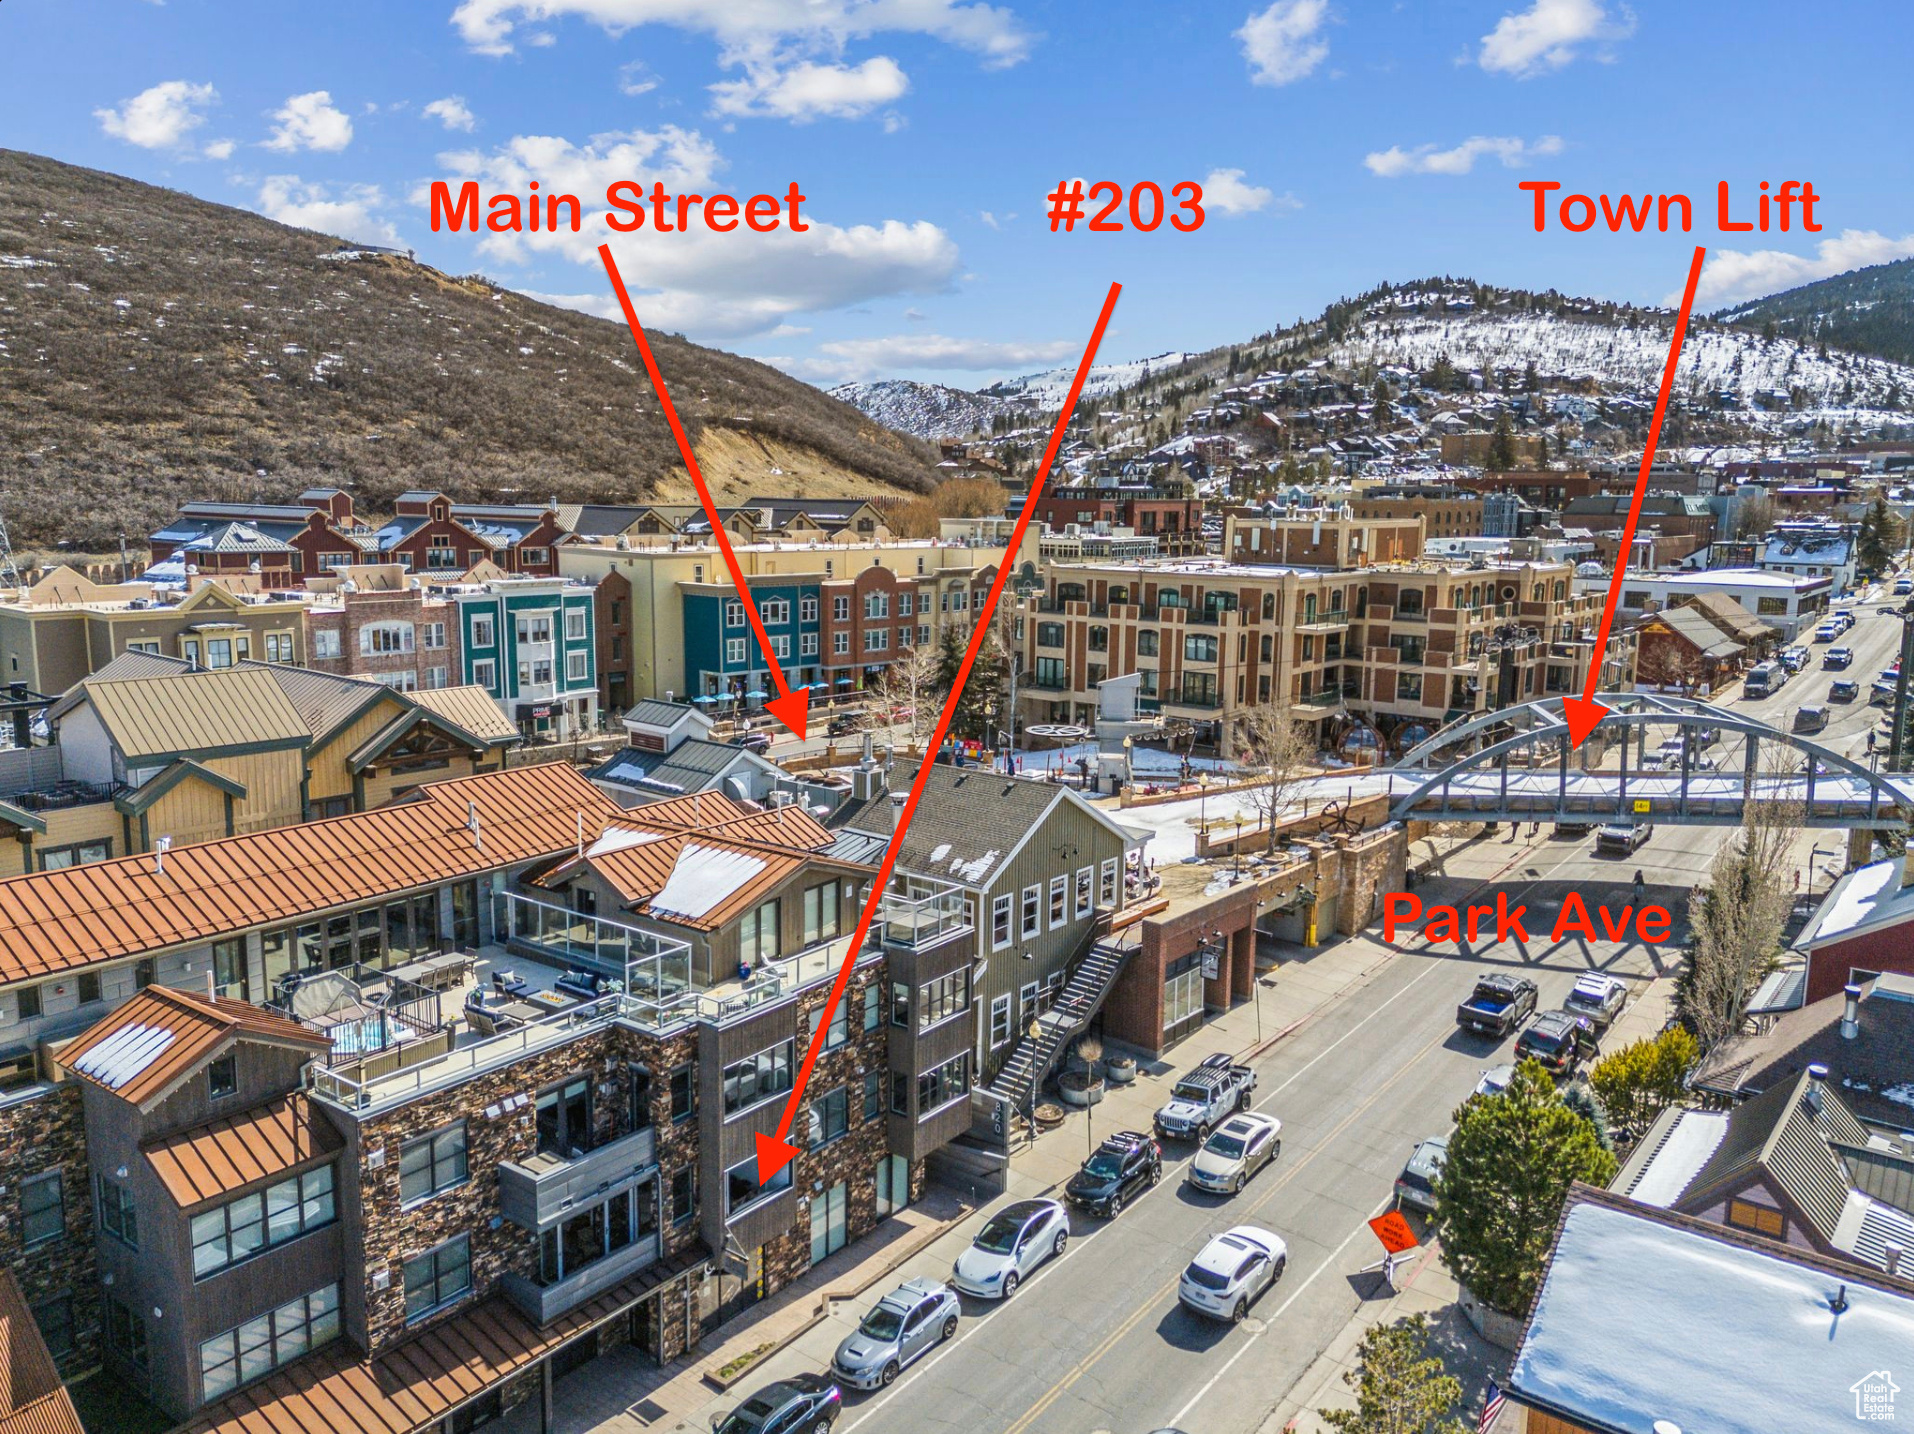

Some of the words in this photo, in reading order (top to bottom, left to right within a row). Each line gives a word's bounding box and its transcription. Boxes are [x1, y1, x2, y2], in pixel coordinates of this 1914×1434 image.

[1384, 1218, 1405, 1230] ROAD
[1383, 1226, 1403, 1239] WORK
[1380, 1233, 1405, 1249] AHEAD
